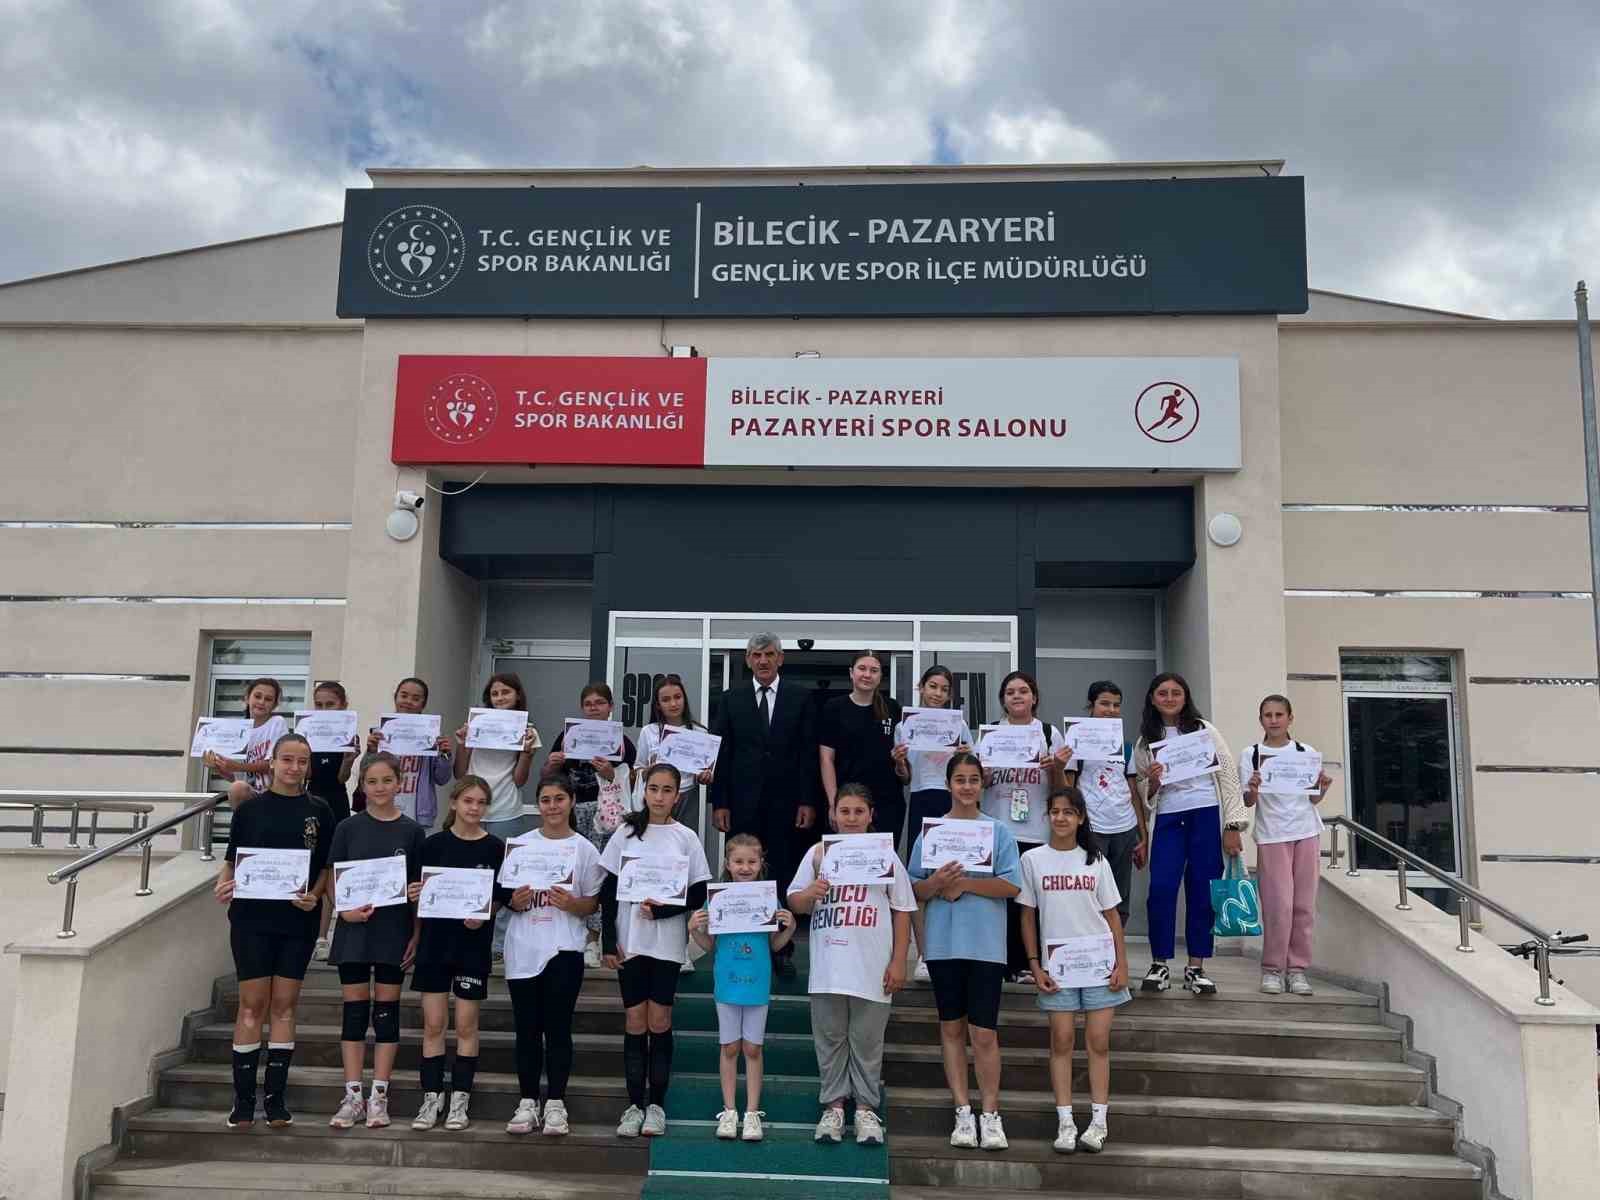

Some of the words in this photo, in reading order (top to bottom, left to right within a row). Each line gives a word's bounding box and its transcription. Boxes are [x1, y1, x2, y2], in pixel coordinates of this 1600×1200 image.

[480, 230, 520, 246] T.C.
[529, 226, 632, 250] GENÇLİK
[642, 230, 671, 246] VE
[714, 215, 840, 246] BİLECİK
[868, 211, 1055, 243] PAZARYERİ
[478, 255, 537, 272] SPOR
[546, 251, 670, 272] BAKANLIĞI
[712, 260, 815, 286] GENÇLİK
[820, 263, 850, 281] VE
[856, 261, 920, 281] SPOR
[927, 258, 976, 284] İLÇE
[984, 255, 1146, 279] MÜDÜRLÜĞÜ
[516, 391, 551, 406] T.C.
[559, 389, 649, 410] GENÇLİK
[658, 393, 684, 407] VE
[732, 387, 809, 405] BİLECİK
[829, 387, 943, 406] PAZARYERİ
[515, 413, 567, 428] SPOR
[574, 411, 684, 430] BAKANLIĞI
[731, 414, 874, 437] PAZARYERİ
[882, 418, 950, 437] SPOR
[958, 418, 1067, 438] SALONU
[1042, 875, 1096, 891] CHICAGO
